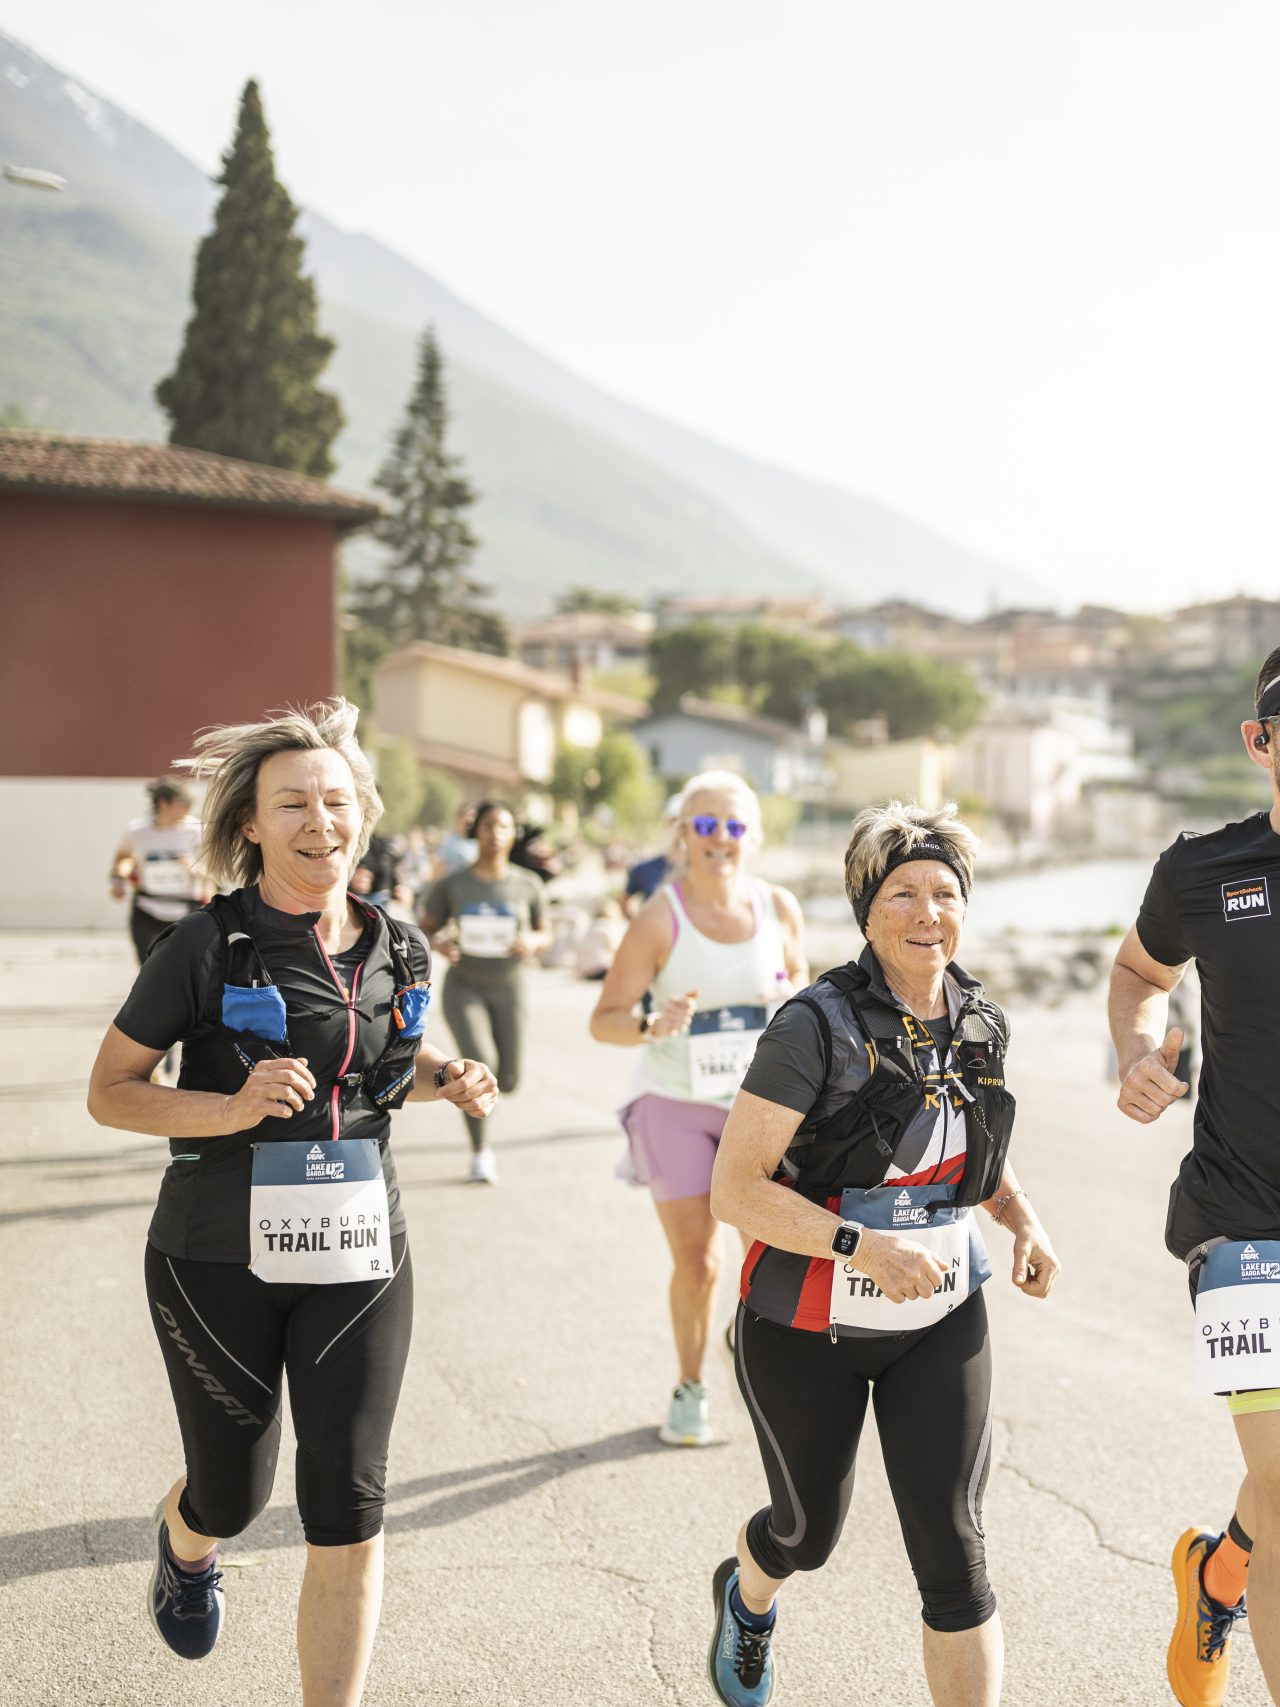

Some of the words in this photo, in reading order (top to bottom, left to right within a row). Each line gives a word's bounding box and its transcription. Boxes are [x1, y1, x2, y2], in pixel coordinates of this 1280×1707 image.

[1227, 893, 1265, 911] RUN
[306, 1153, 326, 1161] PEAK
[306, 1163, 326, 1171] LAKE
[325, 1162, 344, 1179] 42
[893, 1208, 911, 1217] LAKE
[910, 1207, 927, 1225] 42
[260, 1213, 381, 1230] OXYBURN
[264, 1232, 330, 1252] TRAIL
[340, 1228, 378, 1249] RUN
[1240, 1252, 1260, 1260] PEAK
[370, 1260, 380, 1271] 12
[1241, 1263, 1261, 1271] LAKE
[1260, 1262, 1280, 1280] 42
[1206, 1333, 1272, 1359] TRAIL
[155, 1301, 263, 1425] DYNAFIT
